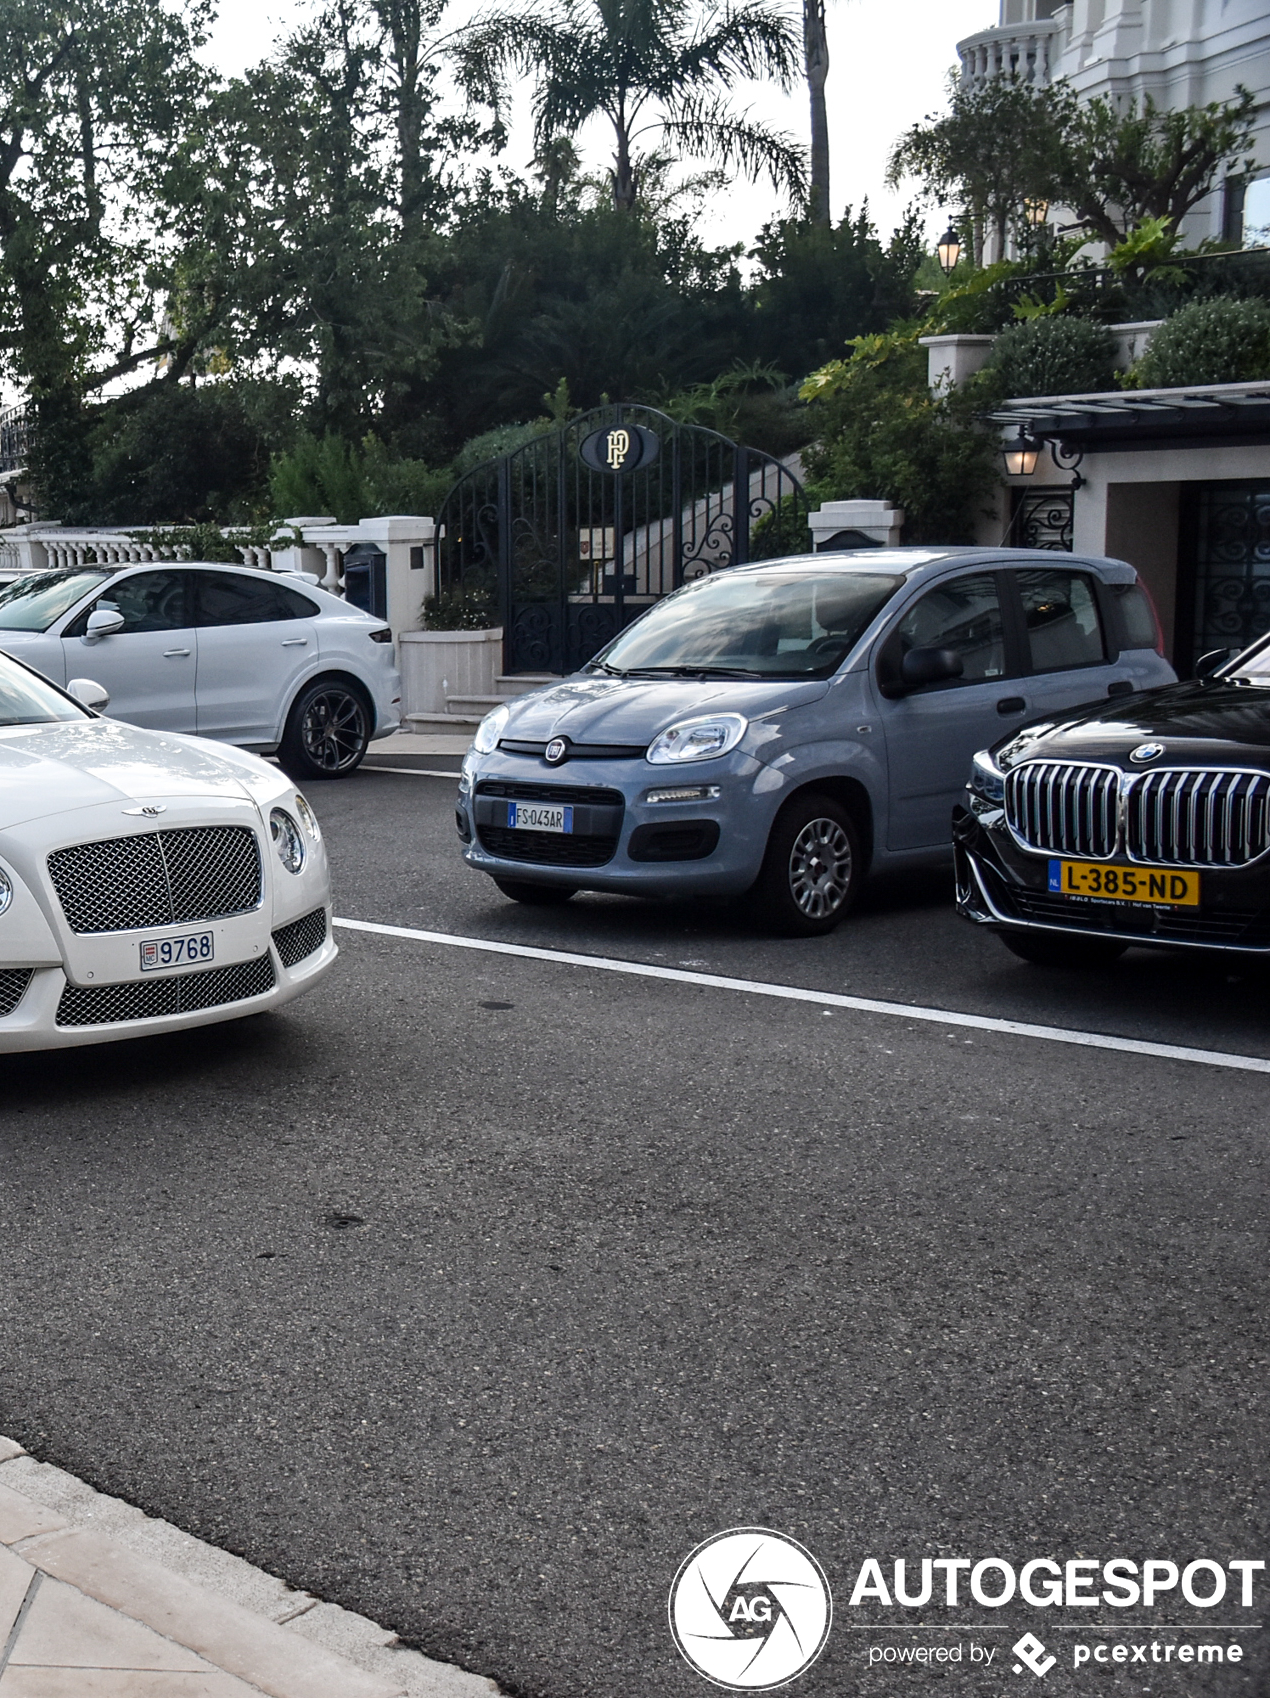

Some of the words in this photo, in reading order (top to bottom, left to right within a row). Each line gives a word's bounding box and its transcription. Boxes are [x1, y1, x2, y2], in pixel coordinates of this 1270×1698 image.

[1049, 878, 1059, 888] NL
[1067, 866, 1188, 900] L-385-ND
[160, 935, 211, 964] 9768
